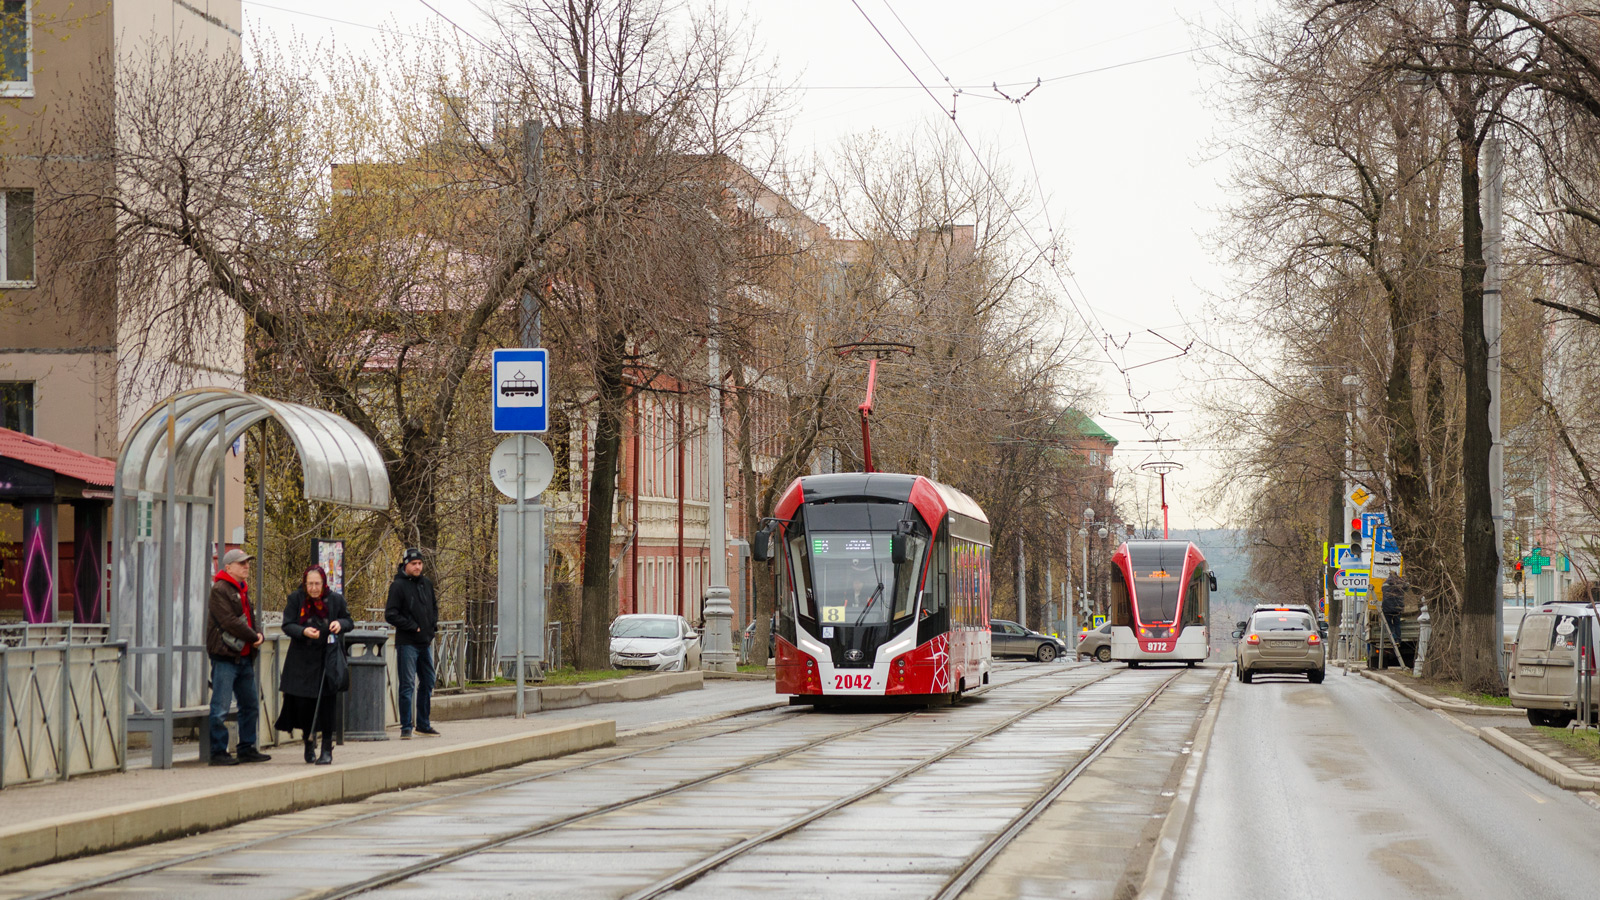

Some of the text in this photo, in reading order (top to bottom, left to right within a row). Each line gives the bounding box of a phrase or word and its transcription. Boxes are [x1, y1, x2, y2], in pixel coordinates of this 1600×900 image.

[1342, 578, 1367, 586] СТОП
[827, 608, 839, 622] 8
[1147, 642, 1167, 651] 9772
[834, 674, 872, 690] 2042
